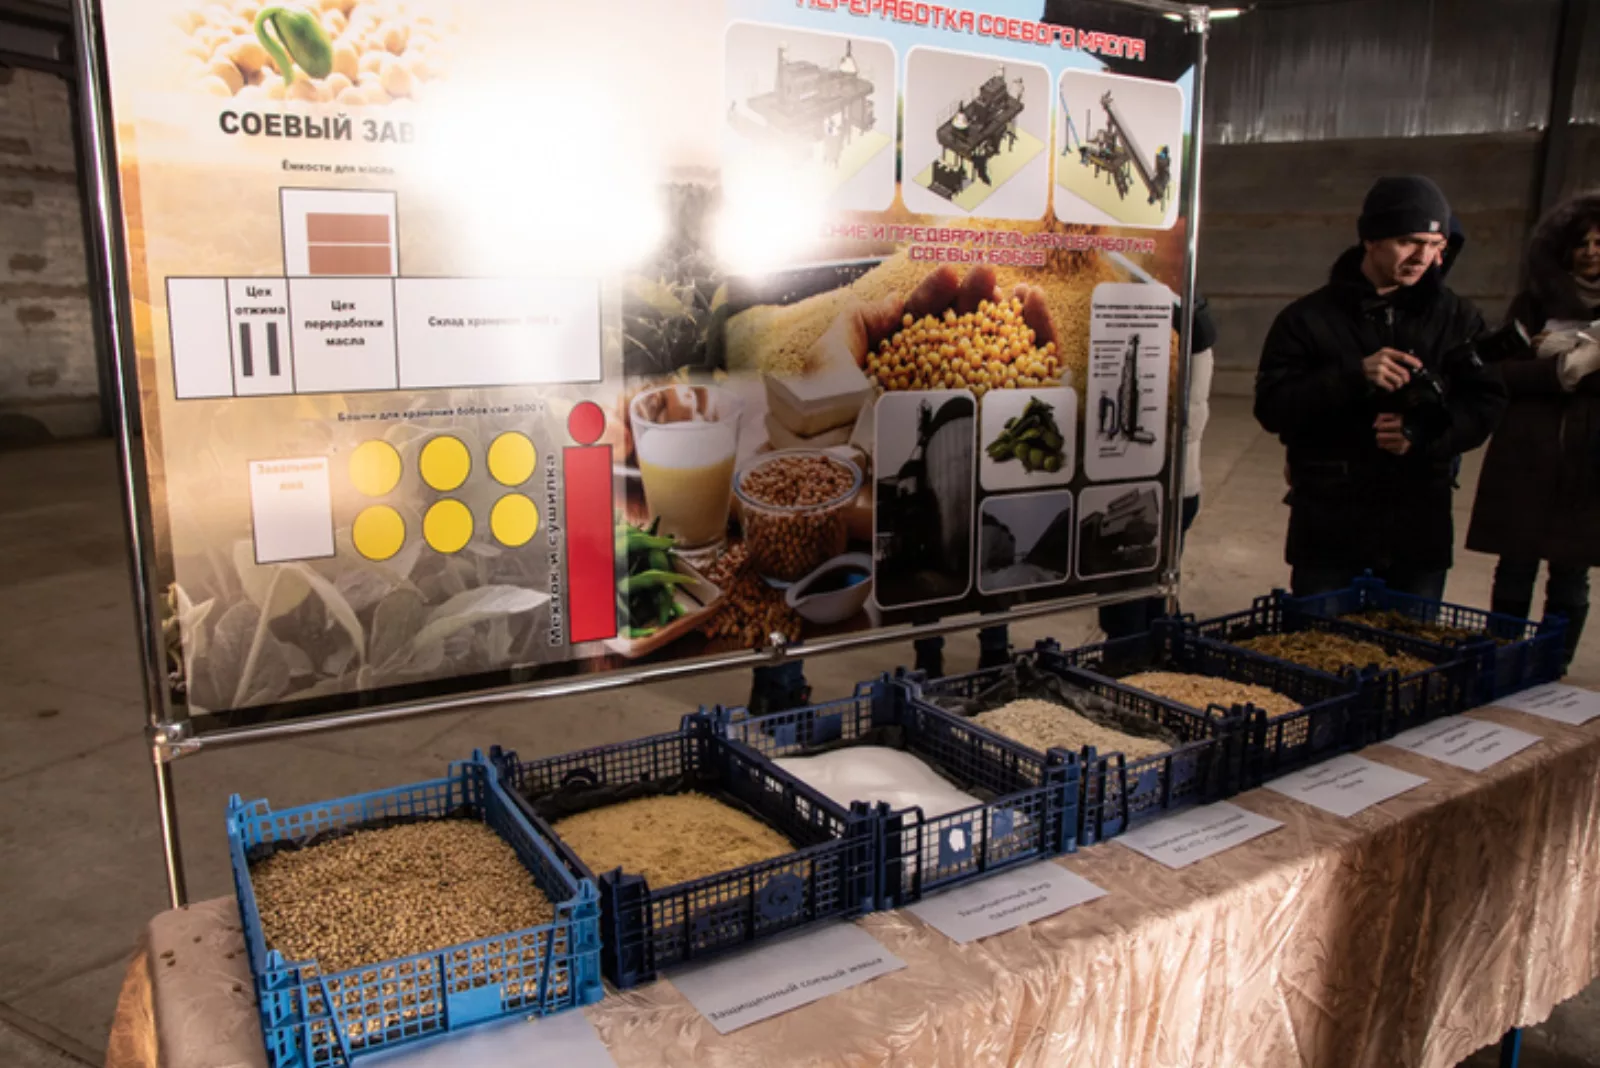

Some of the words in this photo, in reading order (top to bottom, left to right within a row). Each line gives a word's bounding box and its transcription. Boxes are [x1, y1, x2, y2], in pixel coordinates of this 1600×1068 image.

[978, 13, 1075, 49] СОЕВОГО
[1077, 29, 1147, 61] МАСЛА
[219, 109, 353, 141] СОЕВЫЙ
[362, 119, 416, 144] ЗАВ
[873, 226, 886, 240] И
[910, 245, 985, 264] СОЕВЫХ
[246, 286, 272, 299] Цех
[234, 306, 286, 316] отжима
[331, 300, 356, 312] Цех
[304, 318, 383, 330] переработки
[326, 336, 365, 346] масла
